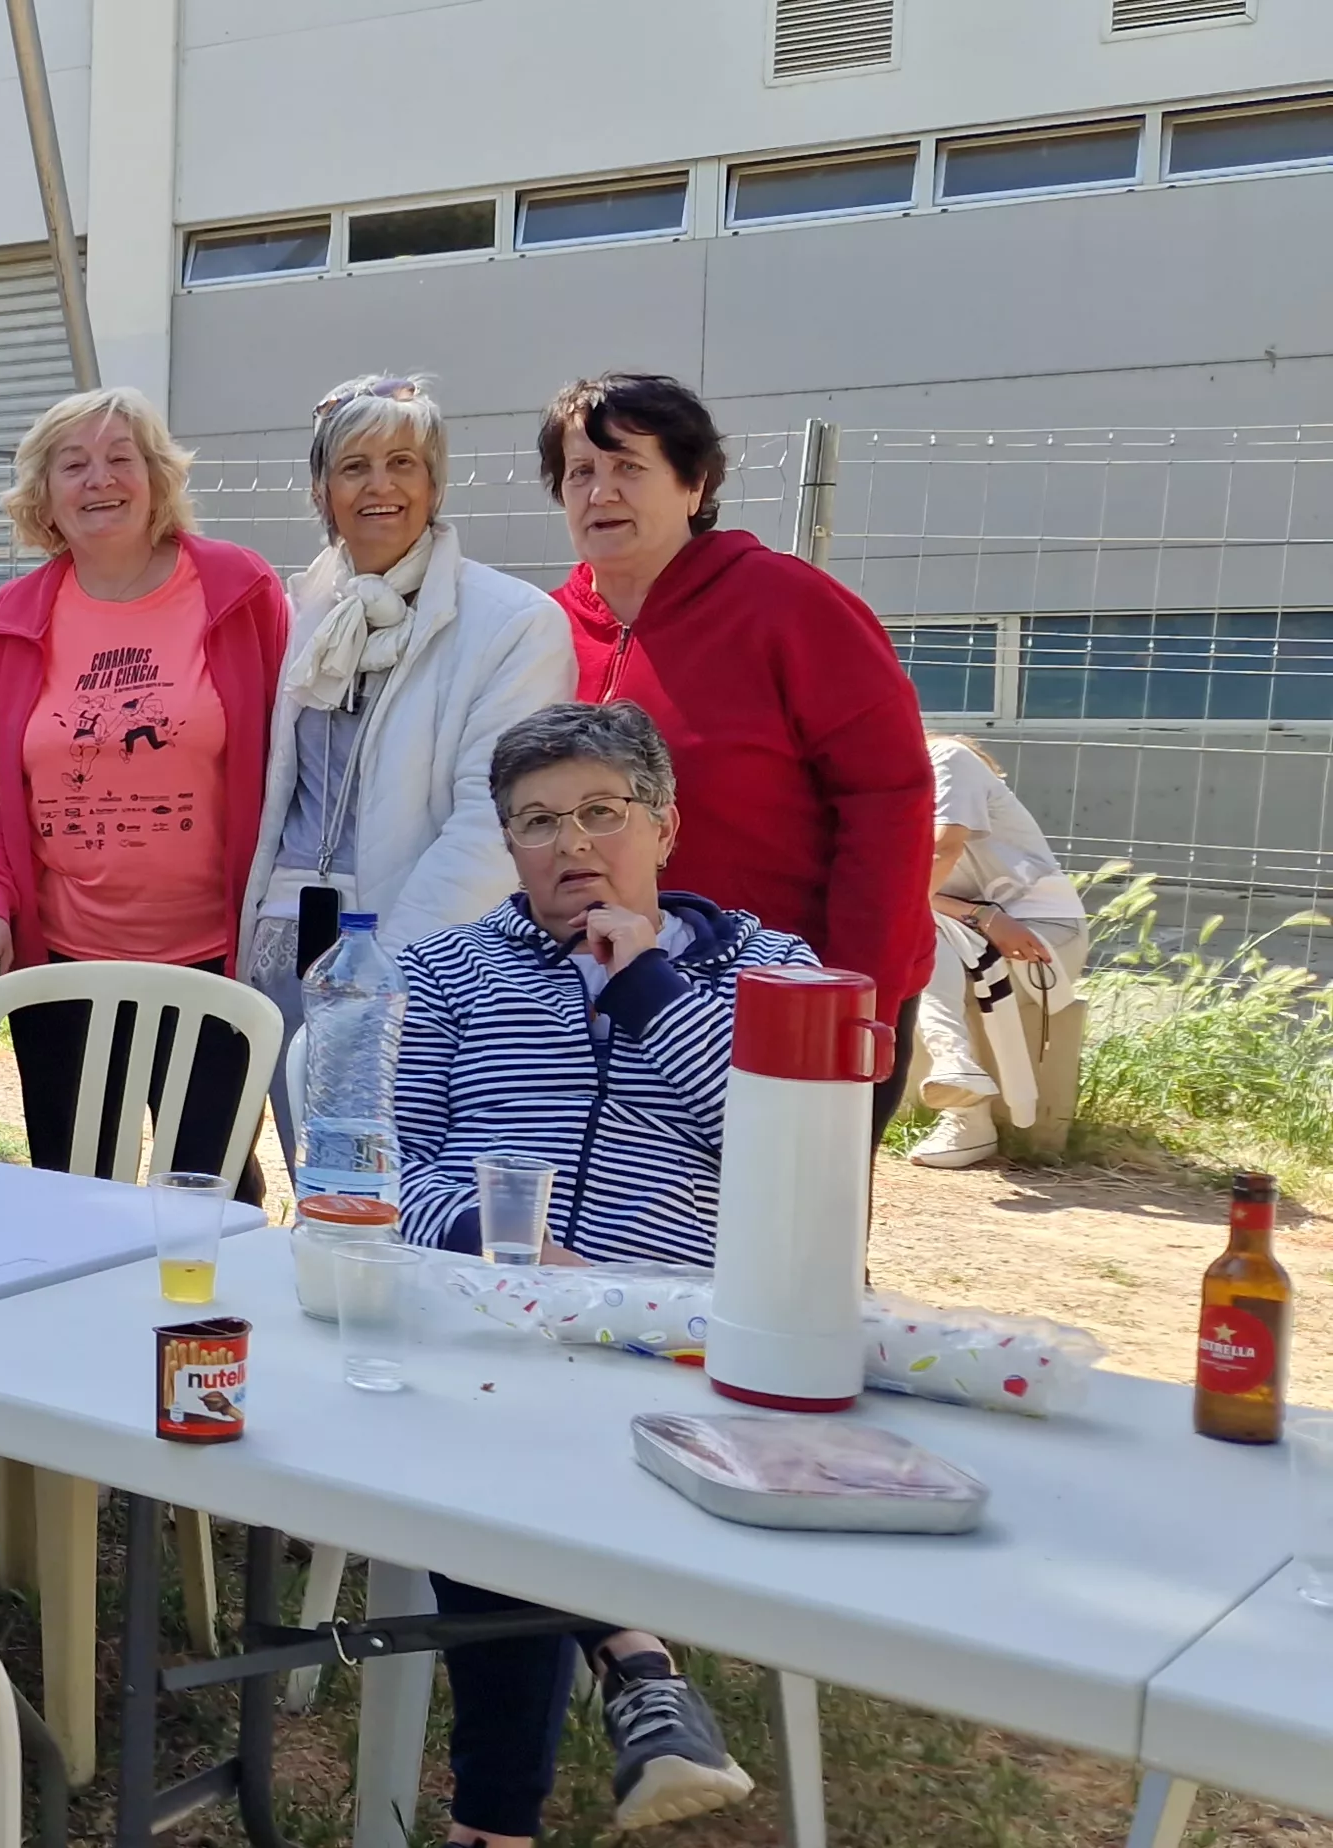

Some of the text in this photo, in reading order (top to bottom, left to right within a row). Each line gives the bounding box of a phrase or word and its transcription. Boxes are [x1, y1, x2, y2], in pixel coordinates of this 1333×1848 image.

[91, 647, 153, 672] CORRAMOS
[74, 672, 100, 692] POR
[99, 670, 113, 690] LA
[114, 664, 160, 688] CIENCIA
[188, 1362, 245, 1389] nutell
